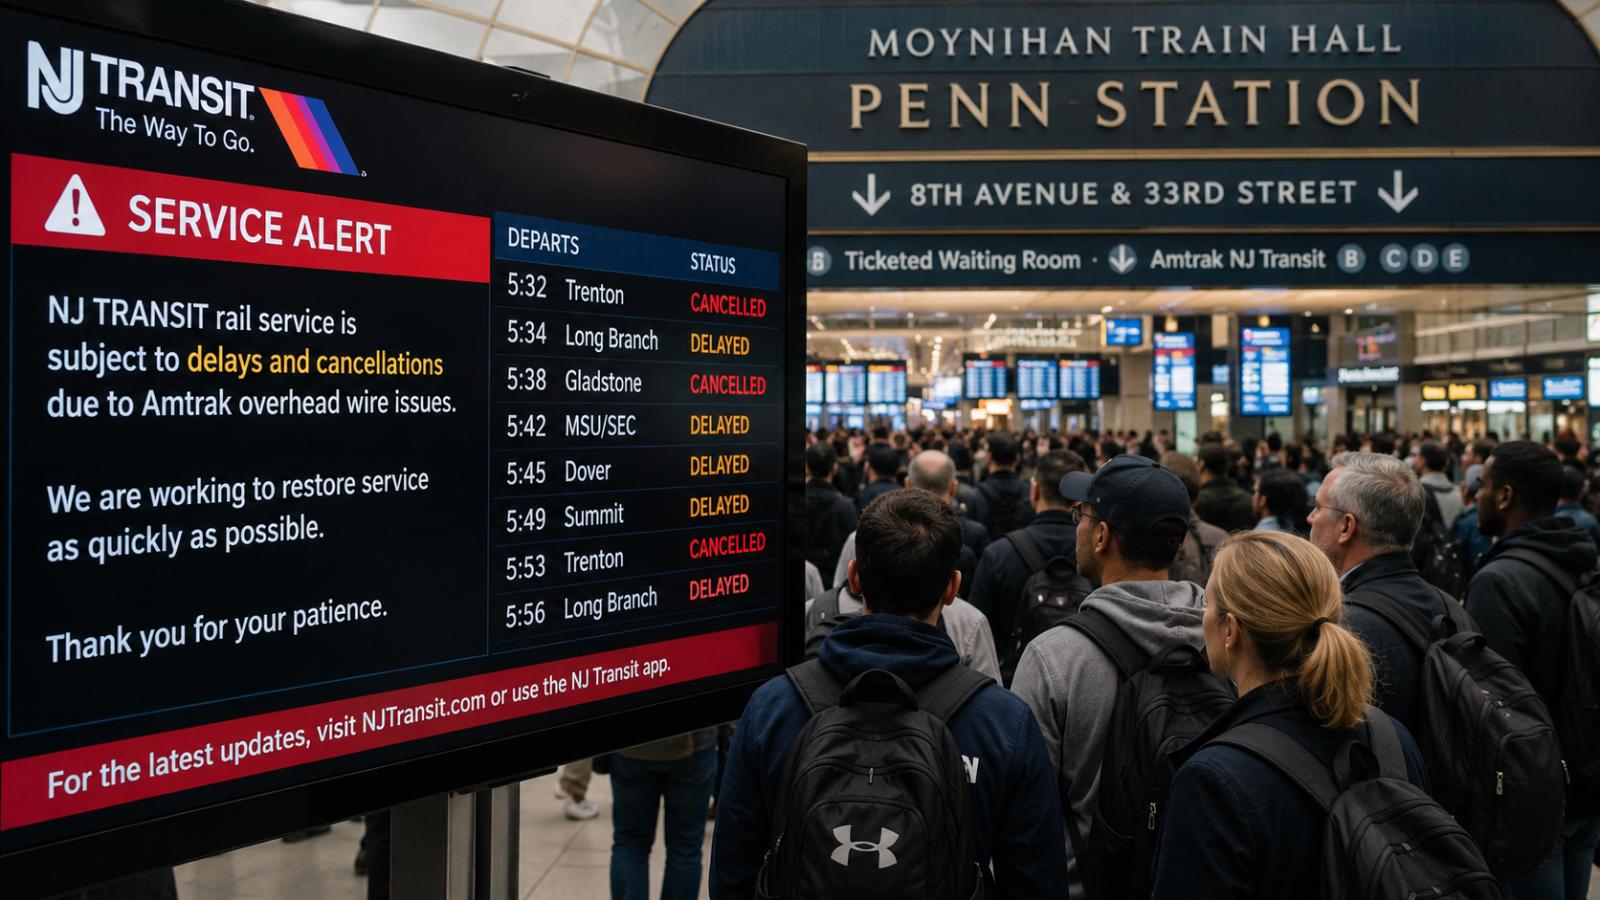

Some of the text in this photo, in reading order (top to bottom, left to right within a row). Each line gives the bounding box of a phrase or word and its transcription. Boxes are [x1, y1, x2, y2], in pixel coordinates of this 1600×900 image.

[868, 24, 1401, 57] MOYNIHAN TRAIN HALL
[27, 40, 84, 115] NJ
[850, 78, 1419, 129] PENN STATION
[95, 106, 255, 153] The Way To Go.
[910, 180, 1357, 207] 8TH AVENUE & 33RD STREET
[128, 194, 392, 256] SERVICE ALERT
[508, 226, 736, 275] DEPARTS STATUS
[844, 249, 933, 271] Ticketed
[938, 249, 1016, 275] Waiting
[1022, 249, 1081, 270] Room
[1150, 249, 1224, 269] Amtrak
[1229, 249, 1255, 269] NJ
[1259, 248, 1326, 269] Transit
[1345, 249, 1359, 268] B
[1385, 248, 1402, 268] C
[1417, 248, 1433, 268] D
[1449, 248, 1462, 268] E
[49, 295, 357, 335] NJ TRANSIT rail service is
[507, 271, 767, 318] 5:32 Trenton CANCELLED
[47, 341, 444, 380] subject to delays and cancellations
[507, 319, 750, 356] 5:34 Long Branch DELAYED
[47, 388, 456, 418] due to Amtrak overhead wire issues.
[507, 366, 767, 396] 5:38 Gladstone CANCELLED
[507, 414, 750, 439] 5:42 MSU/SEC DELAYED
[46, 467, 429, 514] We are working to restore service
[506, 454, 750, 485] 5:45 Dover DELAYED
[506, 494, 750, 533] 5:49 Summit DELAYED
[47, 513, 324, 565] as quickly as possible.
[506, 531, 767, 581] 5:53 Trenton CANCELLED
[505, 573, 750, 628] 5:56 Long Branch DELAYED
[45, 598, 388, 663] Thank you for your patience.
[48, 658, 671, 799] For the latest updates, visit NJTransit.com or use the NJ Transit app.
